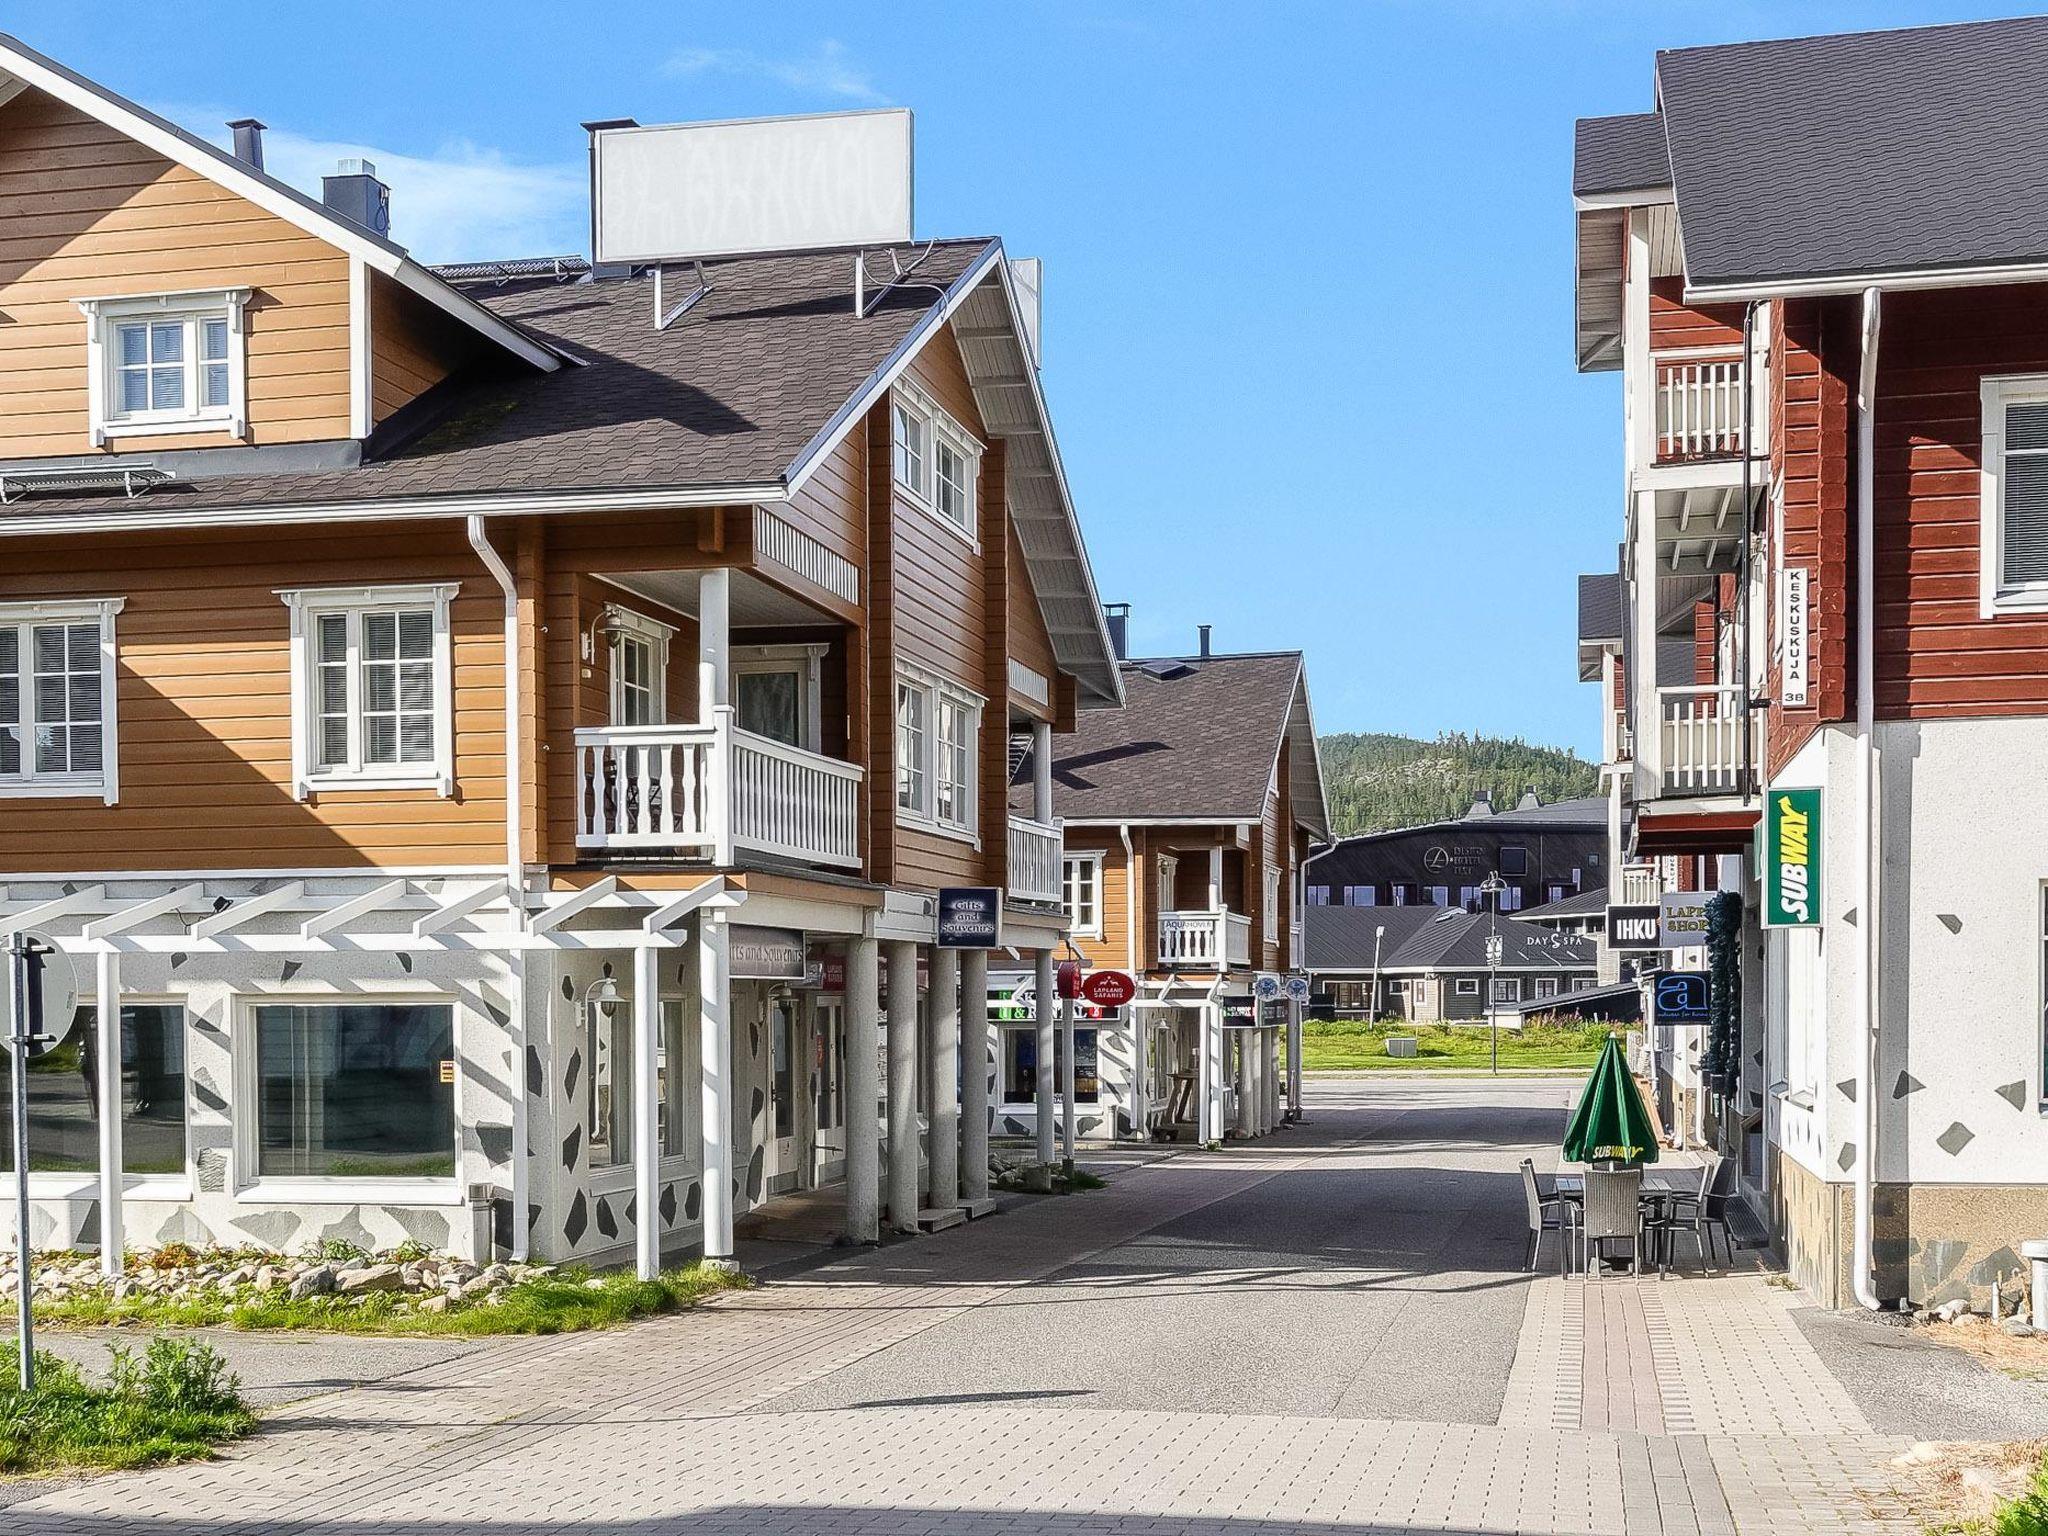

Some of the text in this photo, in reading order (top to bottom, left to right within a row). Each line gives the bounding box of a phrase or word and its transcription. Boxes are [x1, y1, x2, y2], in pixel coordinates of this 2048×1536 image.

[1789, 571, 1801, 680] KESKUSKUJA
[1778, 795, 1810, 923] SUBWAY
[955, 900, 982, 910] Gifts
[957, 912, 979, 921] and
[943, 923, 994, 932] Souvenirs
[1616, 918, 1657, 940] IHKU
[1527, 936, 1549, 946] DAY
[1563, 936, 1583, 946] SPA
[1592, 1145, 1644, 1159] SUBWAY
